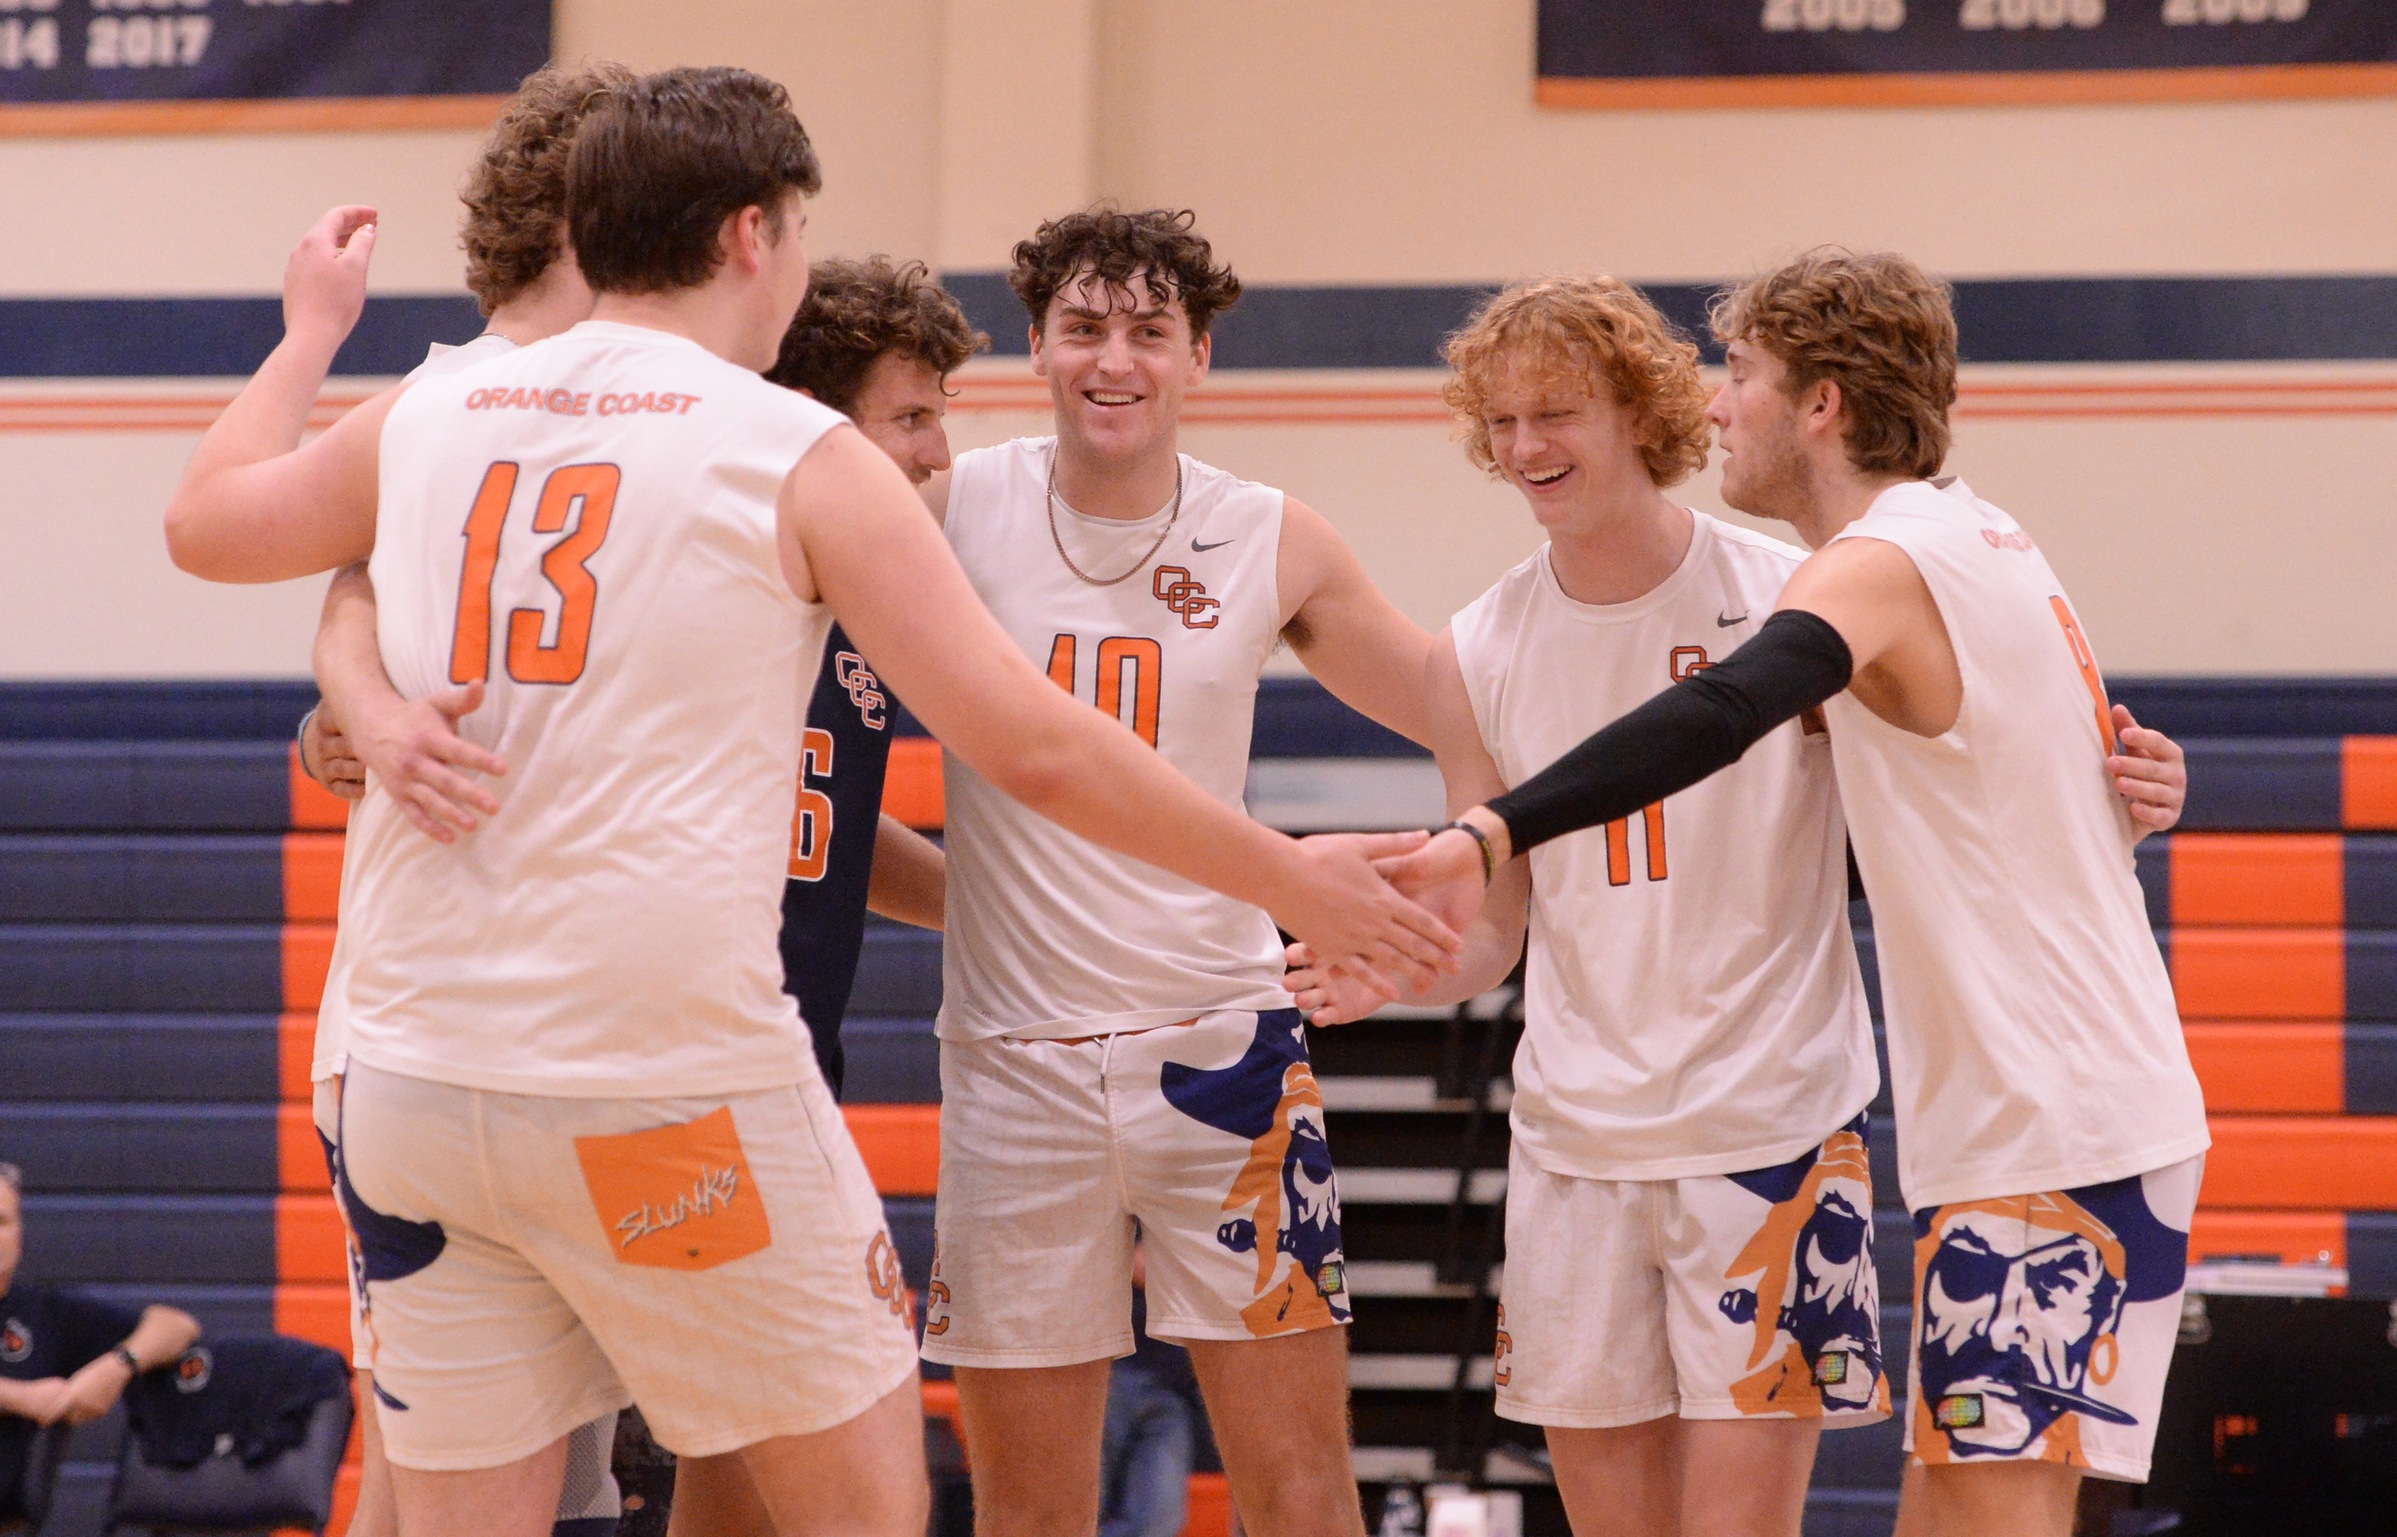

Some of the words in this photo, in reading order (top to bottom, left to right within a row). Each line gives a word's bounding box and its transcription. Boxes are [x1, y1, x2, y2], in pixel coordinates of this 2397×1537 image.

[85, 15, 214, 69] 2017
[464, 387, 592, 417] ORANGE
[595, 392, 703, 417] COAST
[447, 460, 622, 686] 13
[1152, 564, 1221, 630] OCC
[835, 651, 886, 731] OCC
